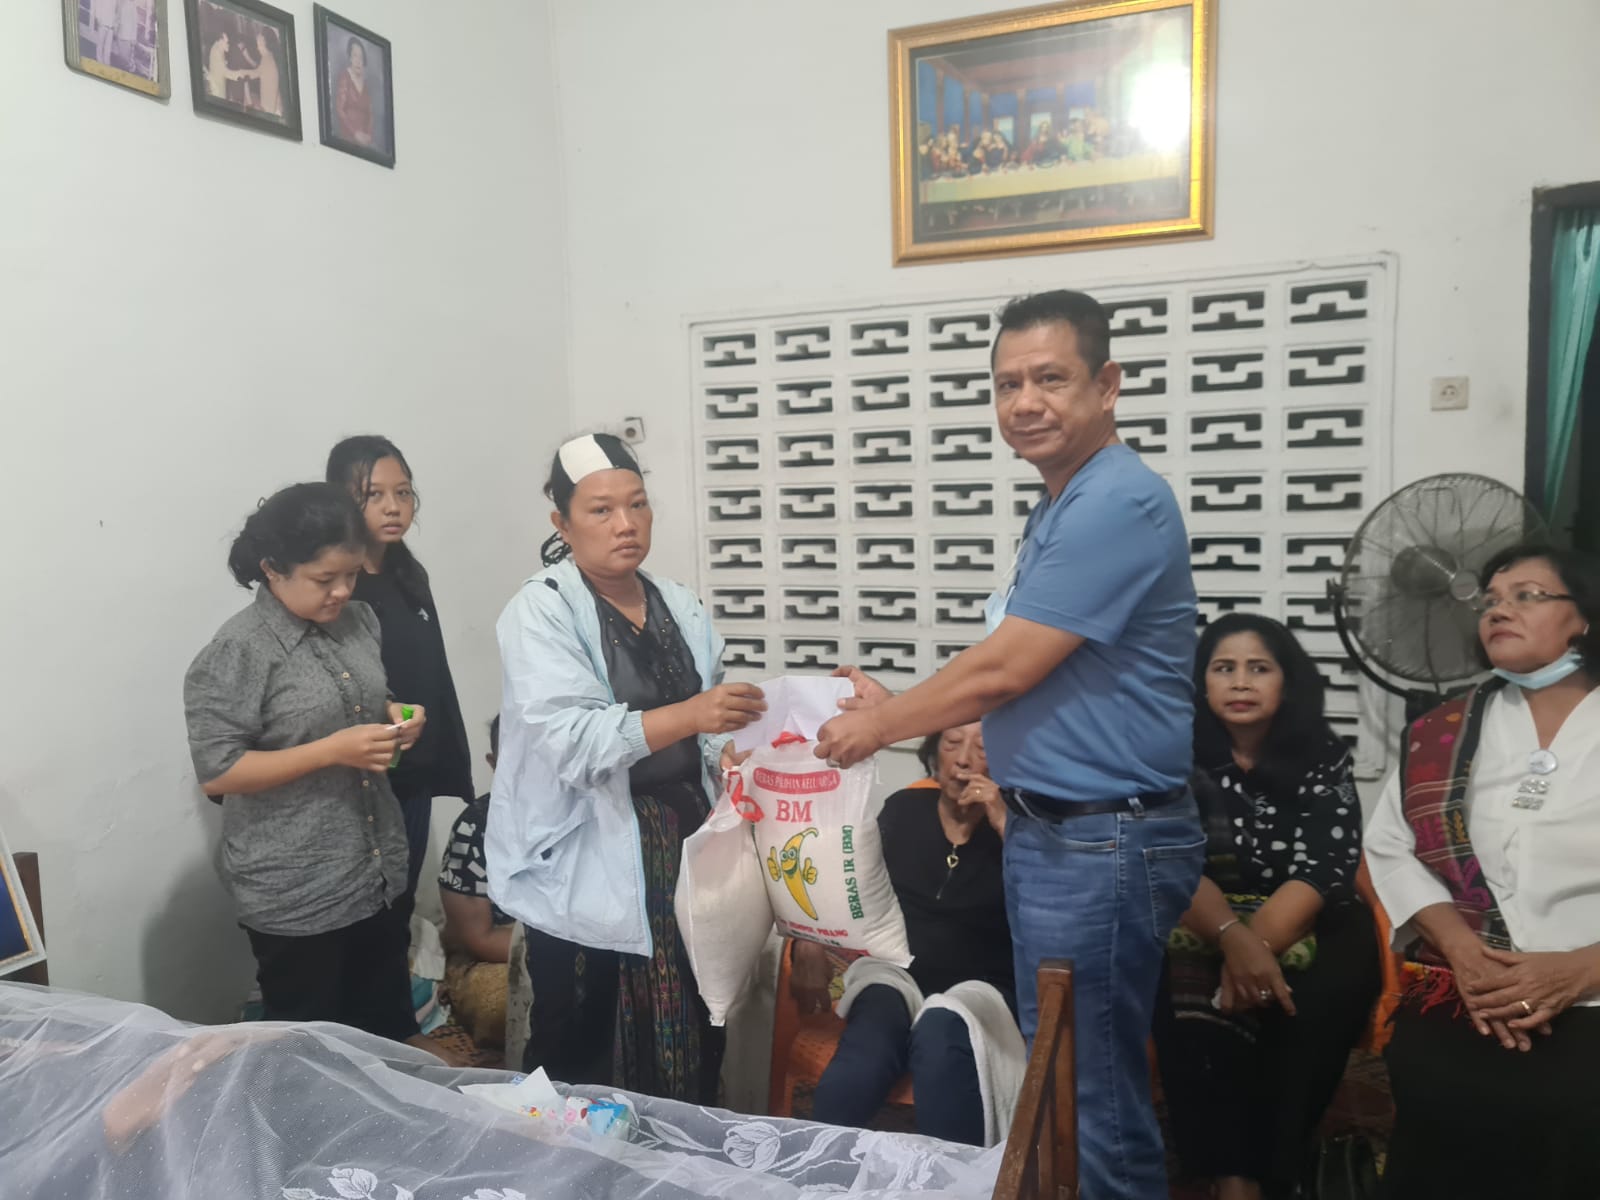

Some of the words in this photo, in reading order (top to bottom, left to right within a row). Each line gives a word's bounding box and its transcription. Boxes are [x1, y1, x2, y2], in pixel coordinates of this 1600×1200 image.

[776, 799, 812, 823] BM
[842, 825, 854, 854] (BM)
[843, 858, 855, 873] IR
[845, 877, 864, 919] BERAS
